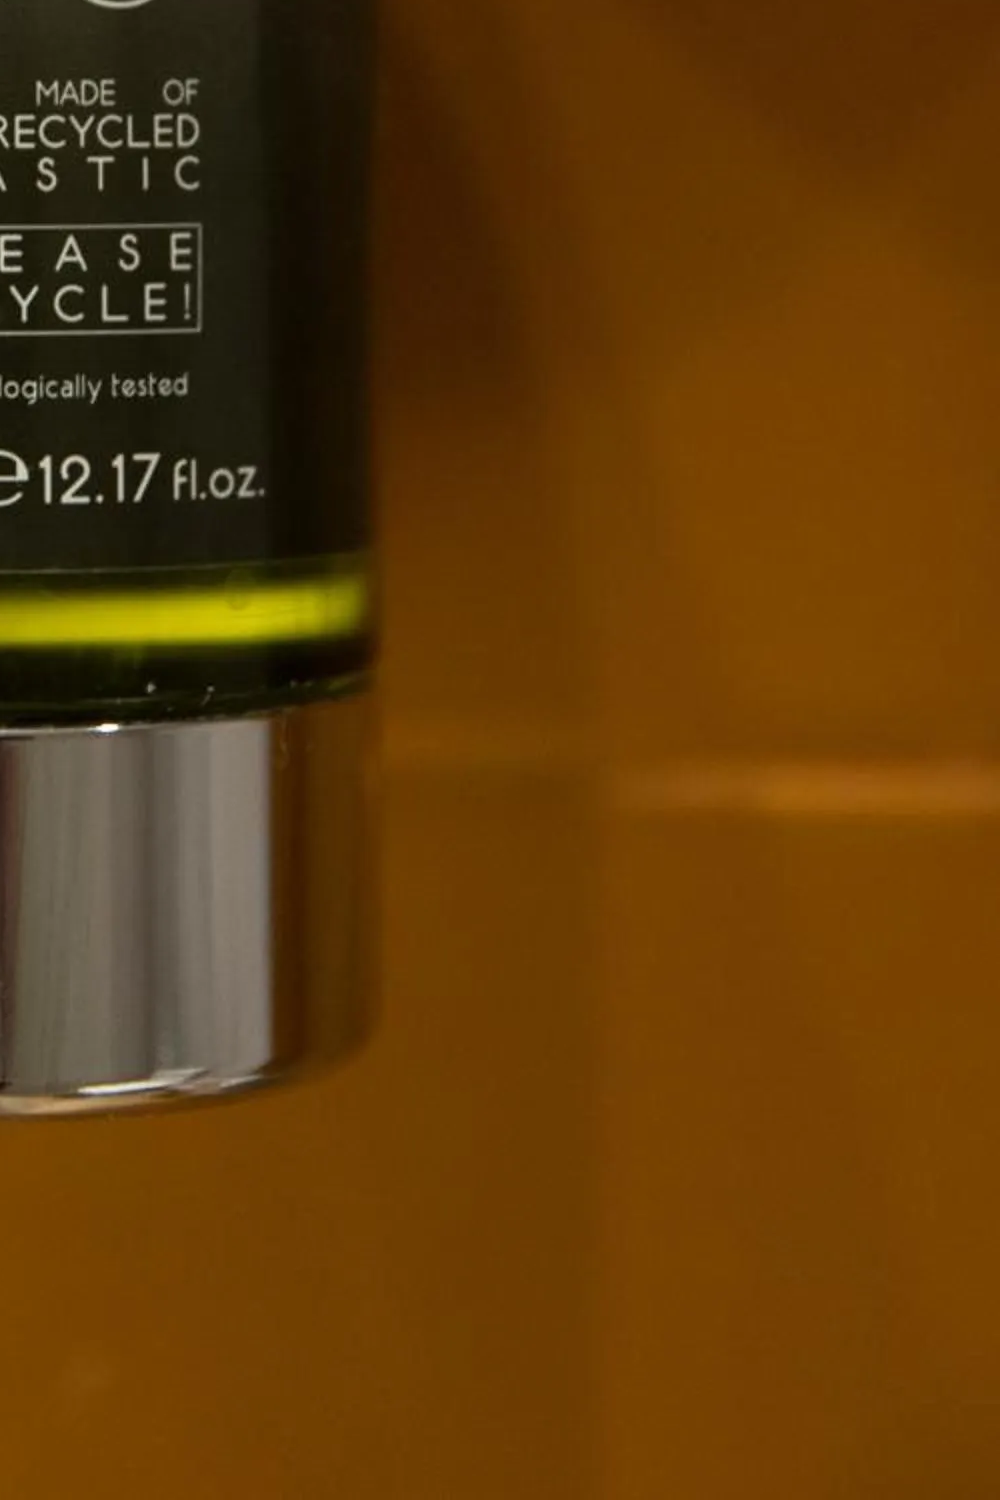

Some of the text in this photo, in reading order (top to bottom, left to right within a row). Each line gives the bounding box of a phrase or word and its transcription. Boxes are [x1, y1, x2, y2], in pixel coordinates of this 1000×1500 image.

[36, 79, 115, 106] MADE
[163, 78, 199, 106] OF
[111, 373, 188, 398] tested
[39, 453, 161, 504] 12.17
[173, 457, 265, 500] fl.oz.
